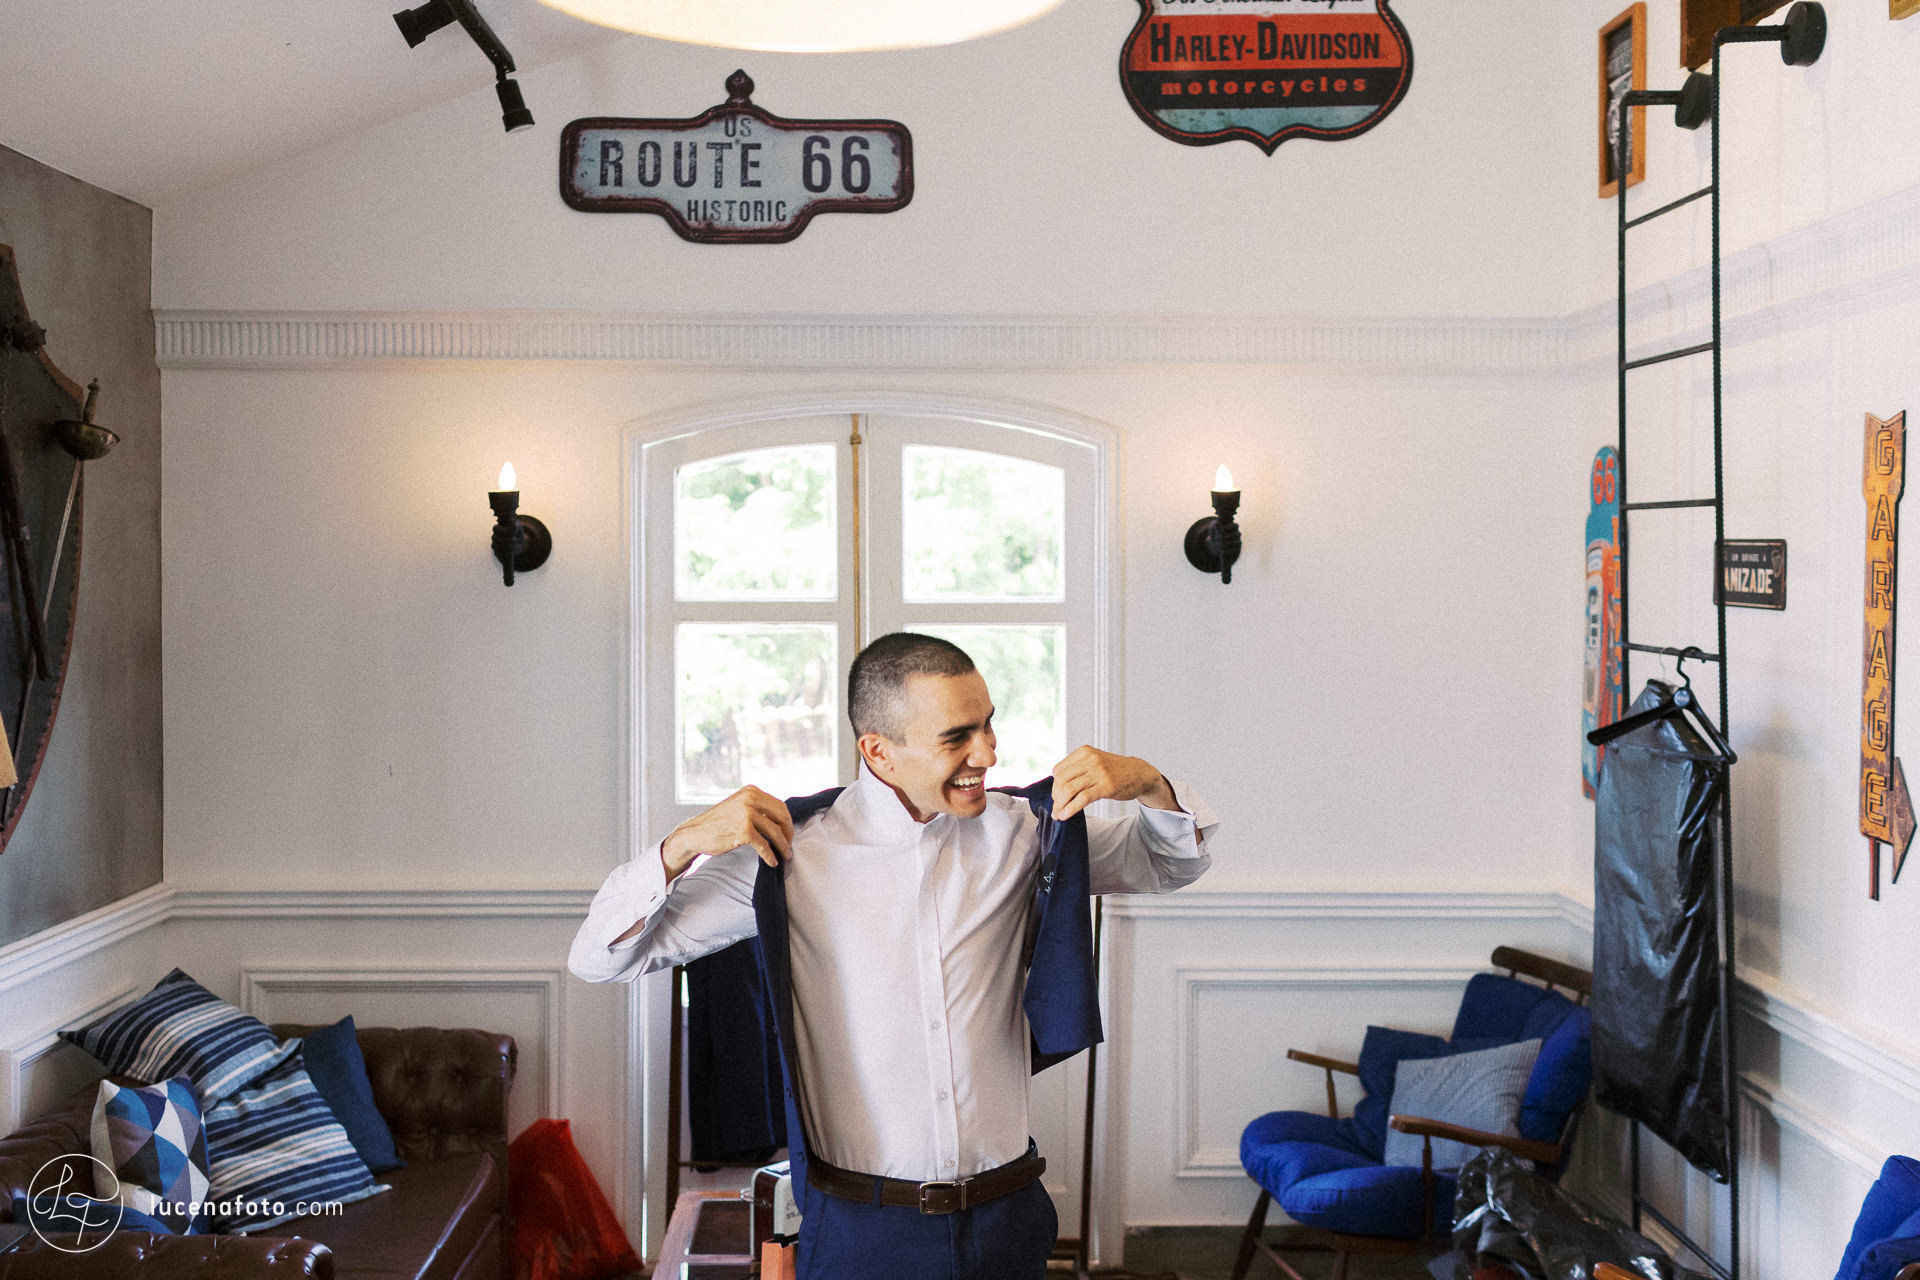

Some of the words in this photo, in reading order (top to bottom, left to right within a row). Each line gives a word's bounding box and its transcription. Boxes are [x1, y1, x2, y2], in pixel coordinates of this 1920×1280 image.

[1150, 21, 1380, 62] HARLEY-DAVIDSON
[1161, 76, 1367, 97] motorcycles
[724, 118, 751, 138] US
[600, 140, 762, 189] ROUTE
[802, 135, 871, 194] 66
[687, 200, 787, 222] HISTORIC
[1593, 456, 1616, 505] 66
[1865, 429, 1894, 829] GARAGE
